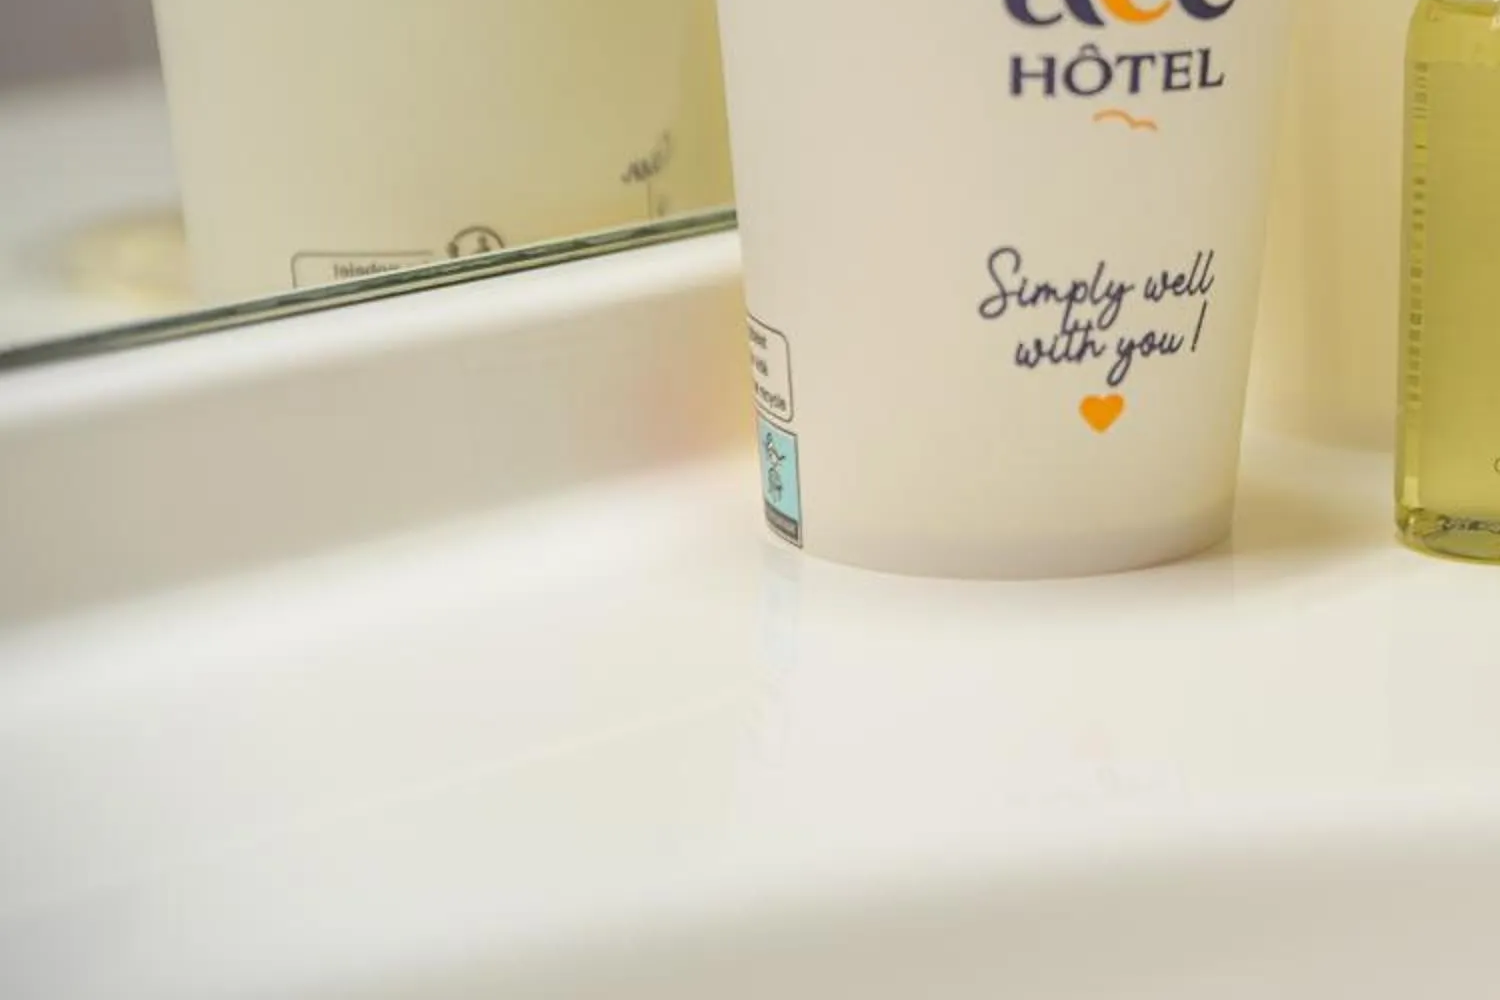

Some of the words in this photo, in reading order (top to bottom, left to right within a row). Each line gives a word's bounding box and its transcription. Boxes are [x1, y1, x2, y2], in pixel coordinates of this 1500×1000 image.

[1009, 43, 1225, 98] HÔTEL
[979, 246, 1136, 331] Simply
[1143, 249, 1215, 302] well
[1014, 318, 1106, 370] with
